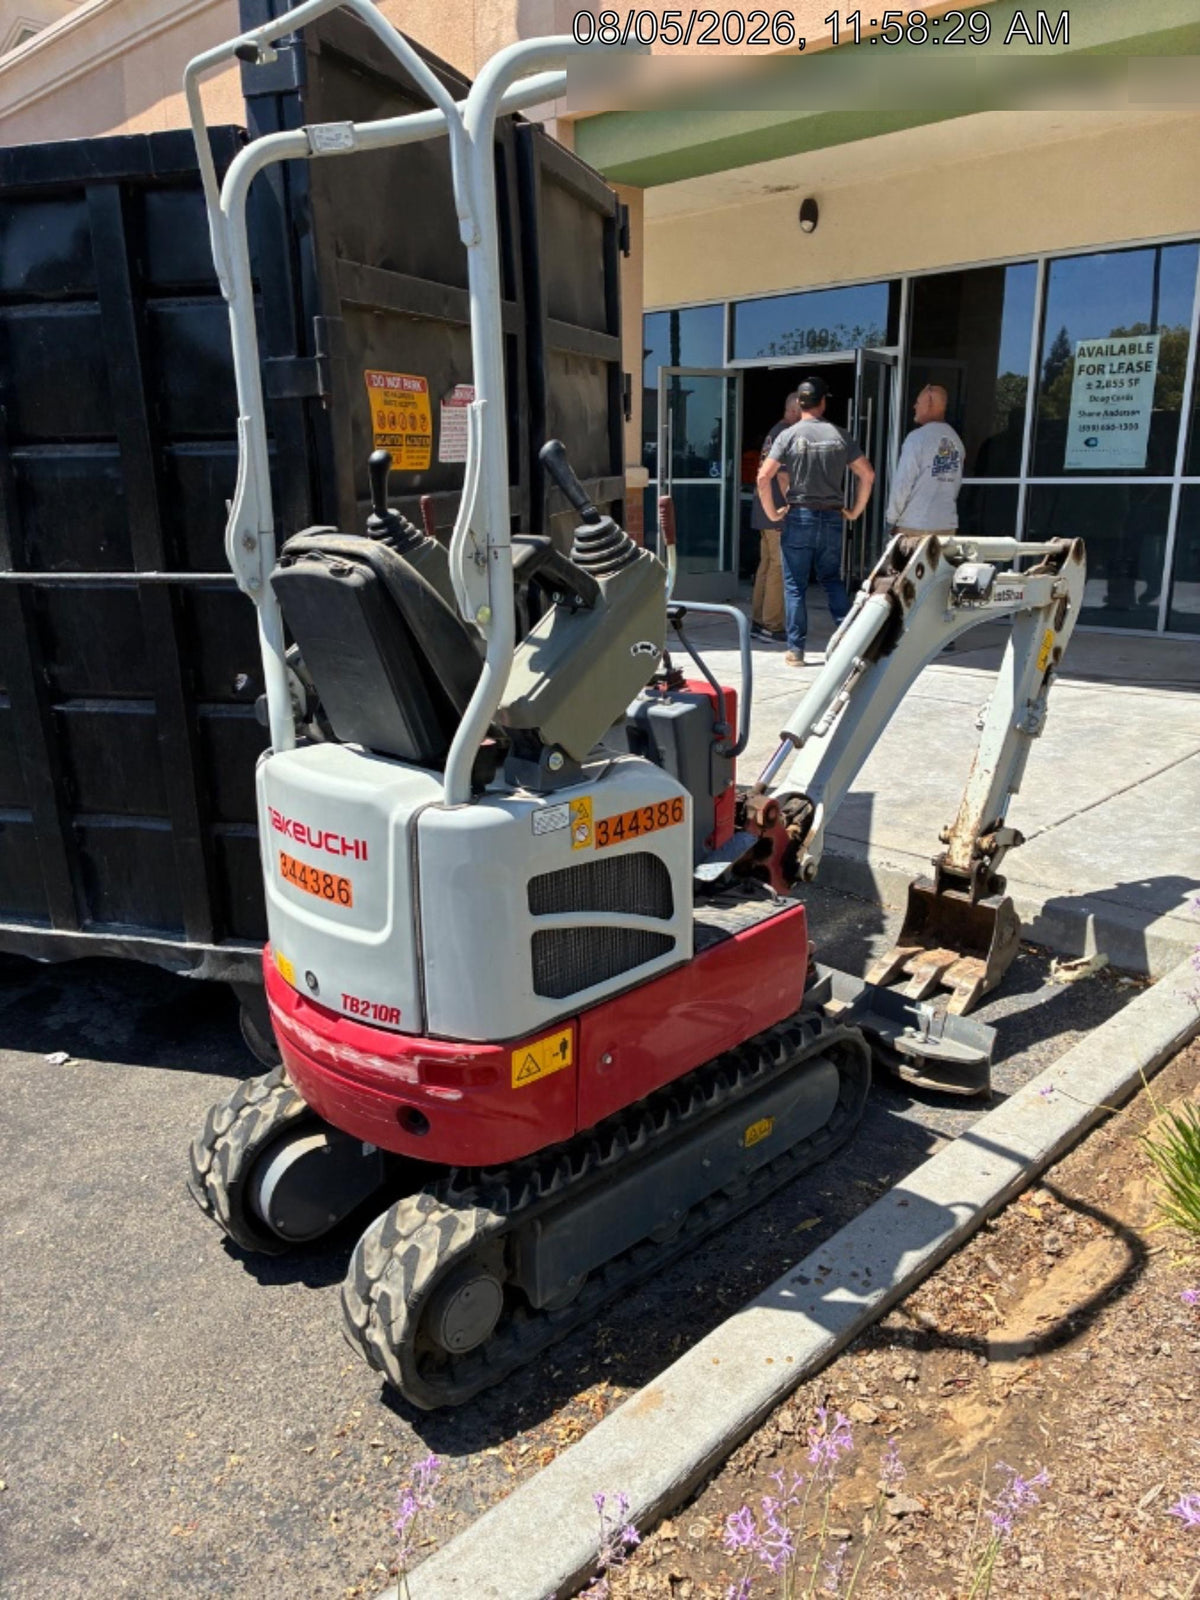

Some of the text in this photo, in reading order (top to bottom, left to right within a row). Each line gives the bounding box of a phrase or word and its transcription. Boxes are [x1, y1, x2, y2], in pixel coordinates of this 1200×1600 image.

[1077, 342, 1154, 358] AVAILABLE
[1077, 360, 1153, 377] FOR LEASE
[370, 374, 423, 391] DO NOT PARK
[1129, 378, 1140, 387] SF
[598, 798, 684, 847] 344386
[279, 853, 350, 905] 344386
[341, 993, 402, 1025] TB210R
